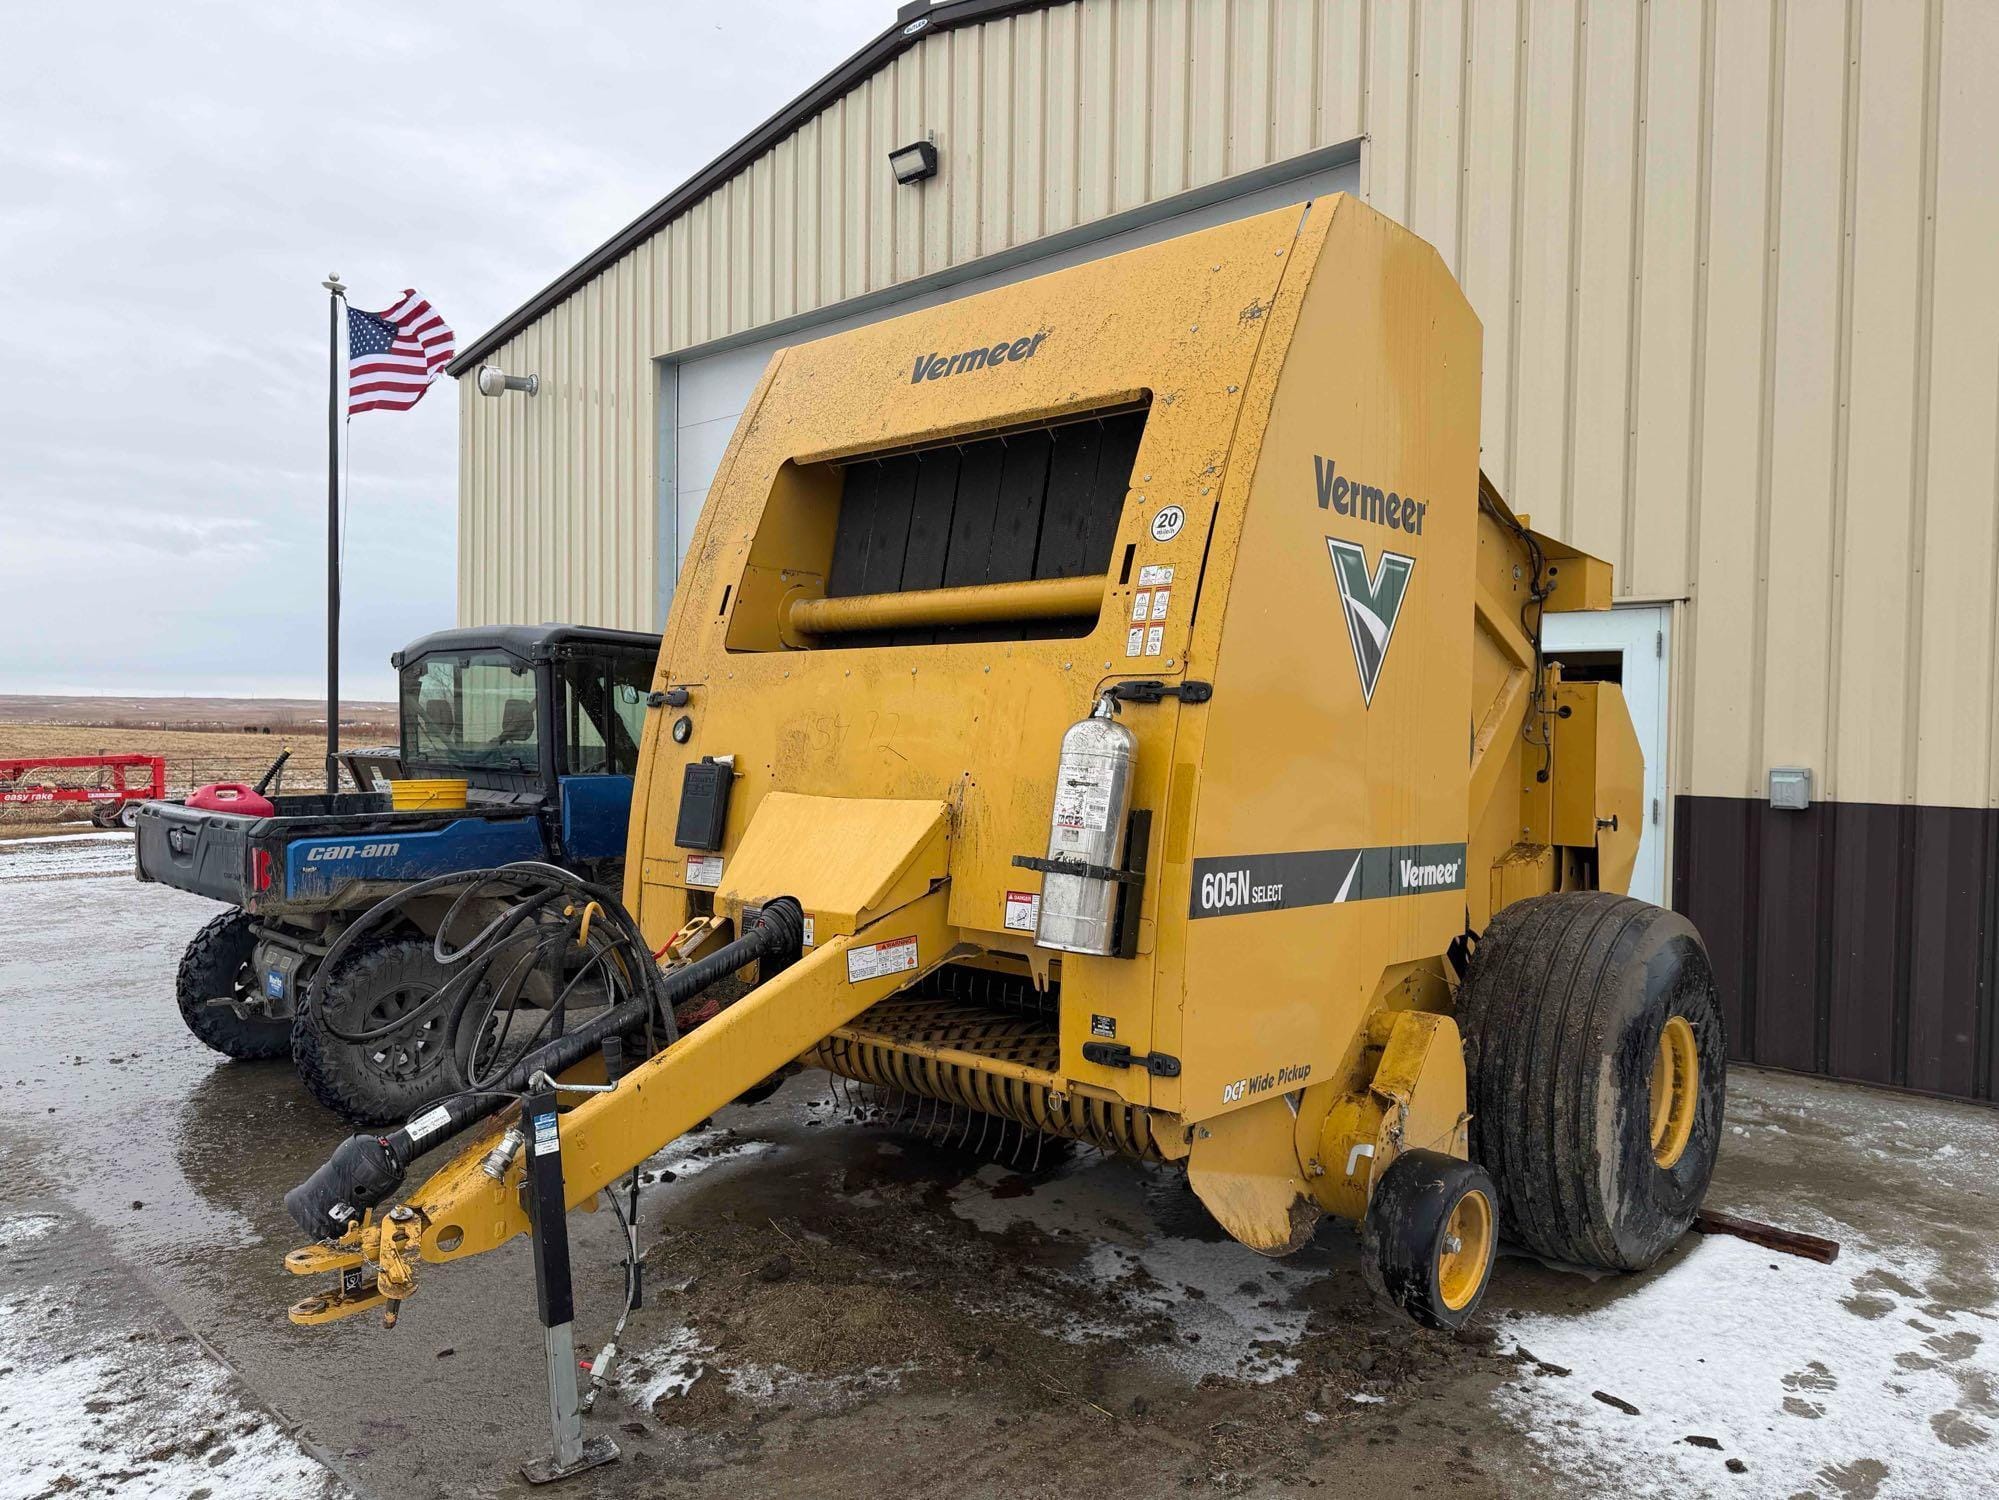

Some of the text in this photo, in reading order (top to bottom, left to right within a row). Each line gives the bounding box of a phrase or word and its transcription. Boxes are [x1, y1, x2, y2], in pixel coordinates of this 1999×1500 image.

[910, 332, 1048, 384] Vermeer
[1314, 454, 1426, 536] Vermeer
[1156, 511, 1178, 529] 20
[4, 792, 54, 802] easy rake
[307, 843, 400, 861] can-am
[1201, 869, 1283, 909] 605N SELECT
[1400, 860, 1459, 888] Vermeer
[1222, 1064, 1311, 1104] DCF Wide Pickup
